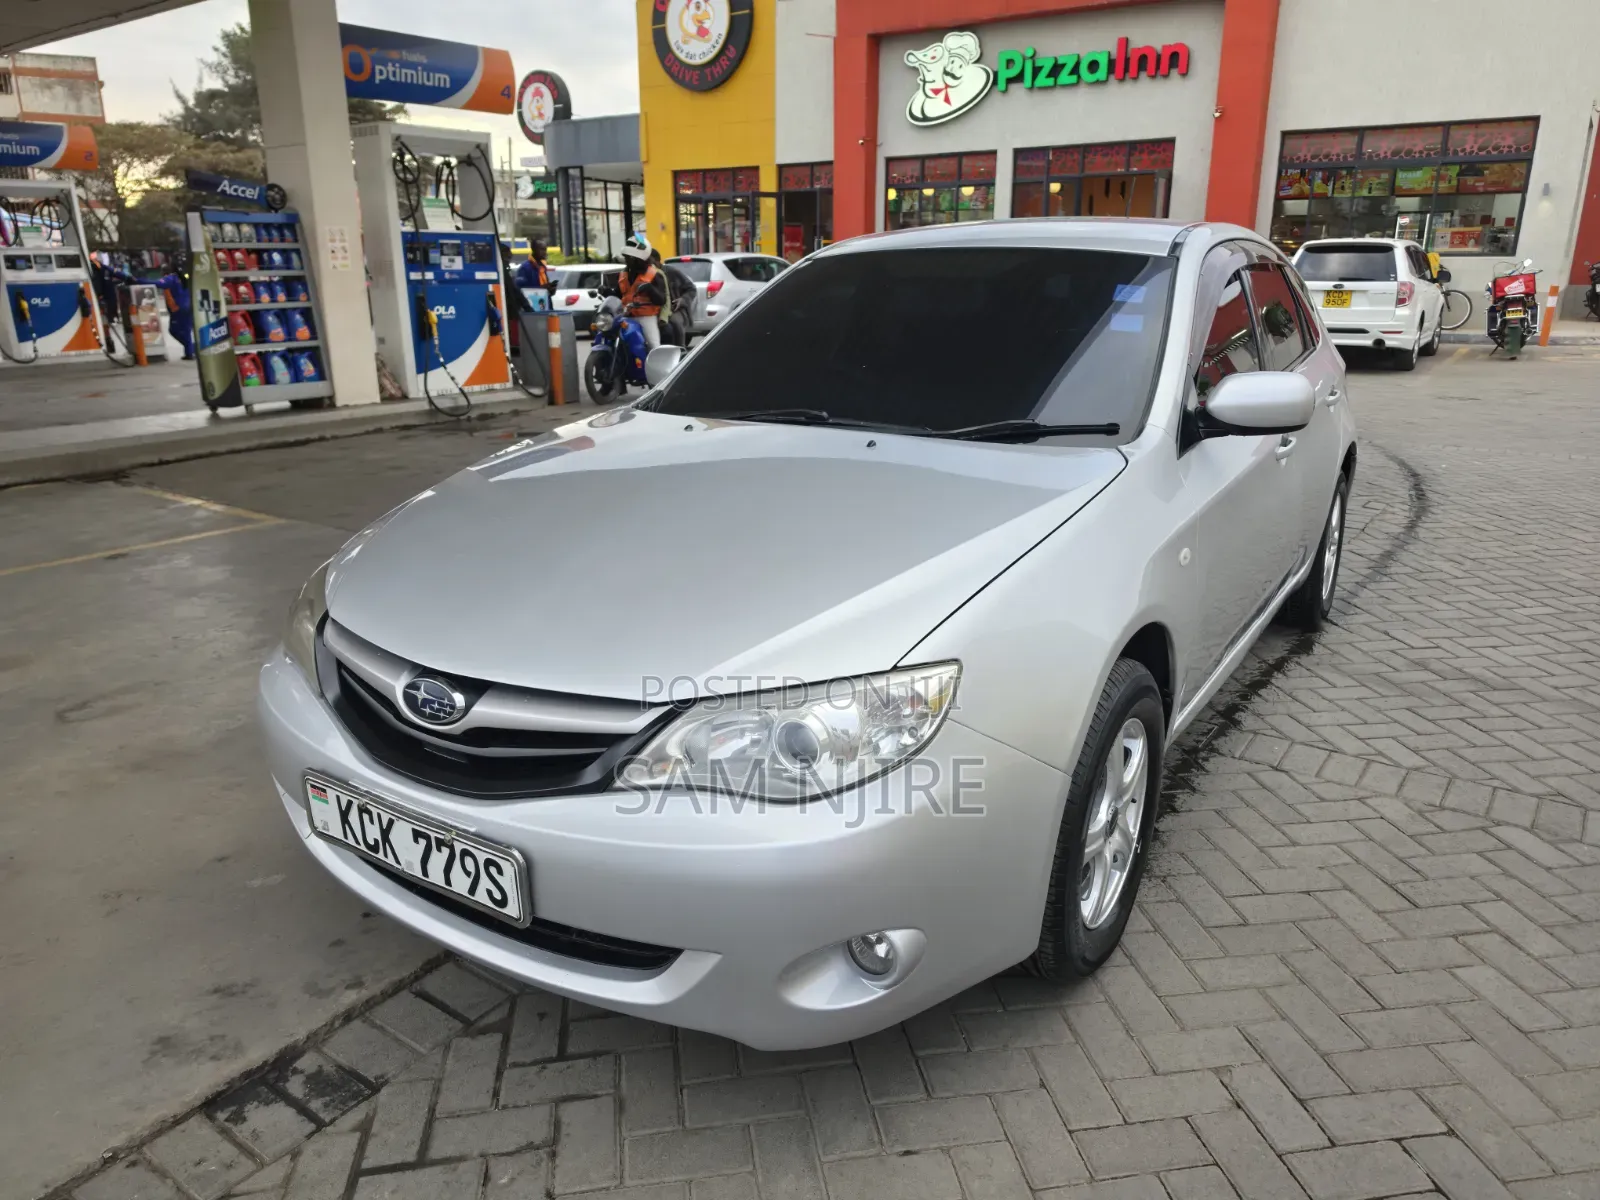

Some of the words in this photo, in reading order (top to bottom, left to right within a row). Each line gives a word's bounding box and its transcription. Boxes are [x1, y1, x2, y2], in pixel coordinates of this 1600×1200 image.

[342, 44, 451, 88] Optimium
[664, 53, 700, 85] DRIVE
[704, 44, 737, 81] THRU
[500, 84, 512, 99] 4
[216, 179, 260, 200] Accel
[30, 297, 51, 305] OLA
[1326, 290, 1344, 298] KCD
[433, 305, 456, 315] OLA
[208, 321, 228, 341] Accel
[336, 794, 402, 867] KCK
[412, 827, 509, 910] 779S
